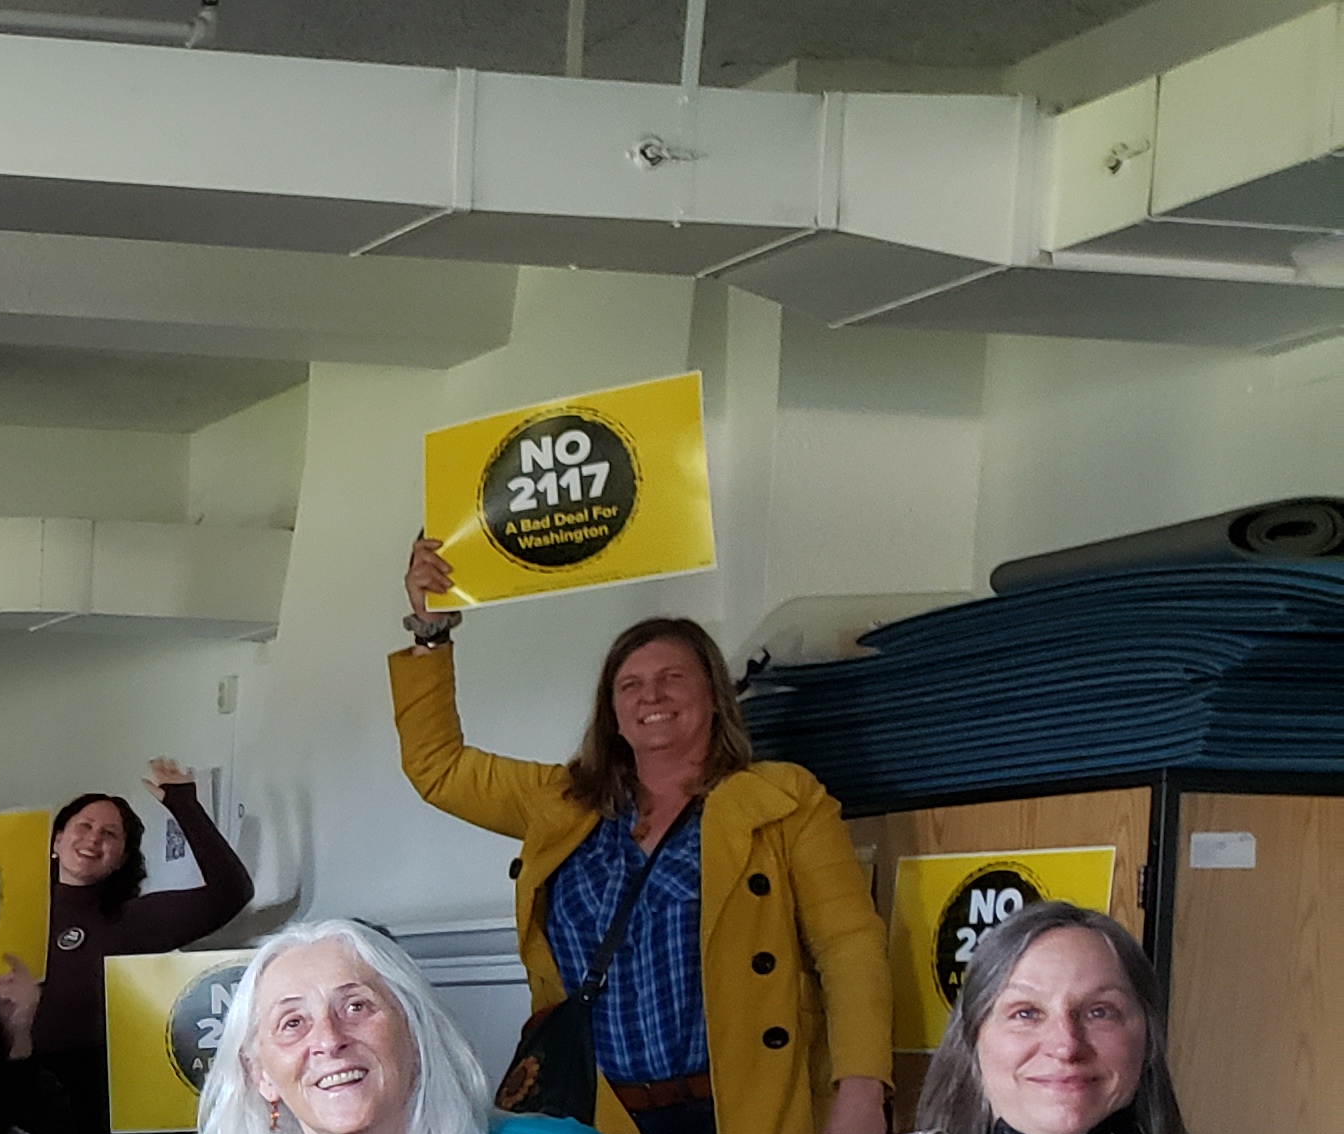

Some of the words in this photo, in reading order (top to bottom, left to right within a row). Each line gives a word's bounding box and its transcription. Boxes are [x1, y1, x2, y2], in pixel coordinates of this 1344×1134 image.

[520, 430, 591, 473] NO
[507, 461, 610, 512] 2117
[505, 521, 518, 536] A
[520, 515, 551, 533] Bad
[554, 507, 590, 527] Deal
[592, 505, 619, 520] For
[517, 524, 609, 549] Washington
[969, 887, 1024, 925] NO
[948, 971, 959, 985] A
